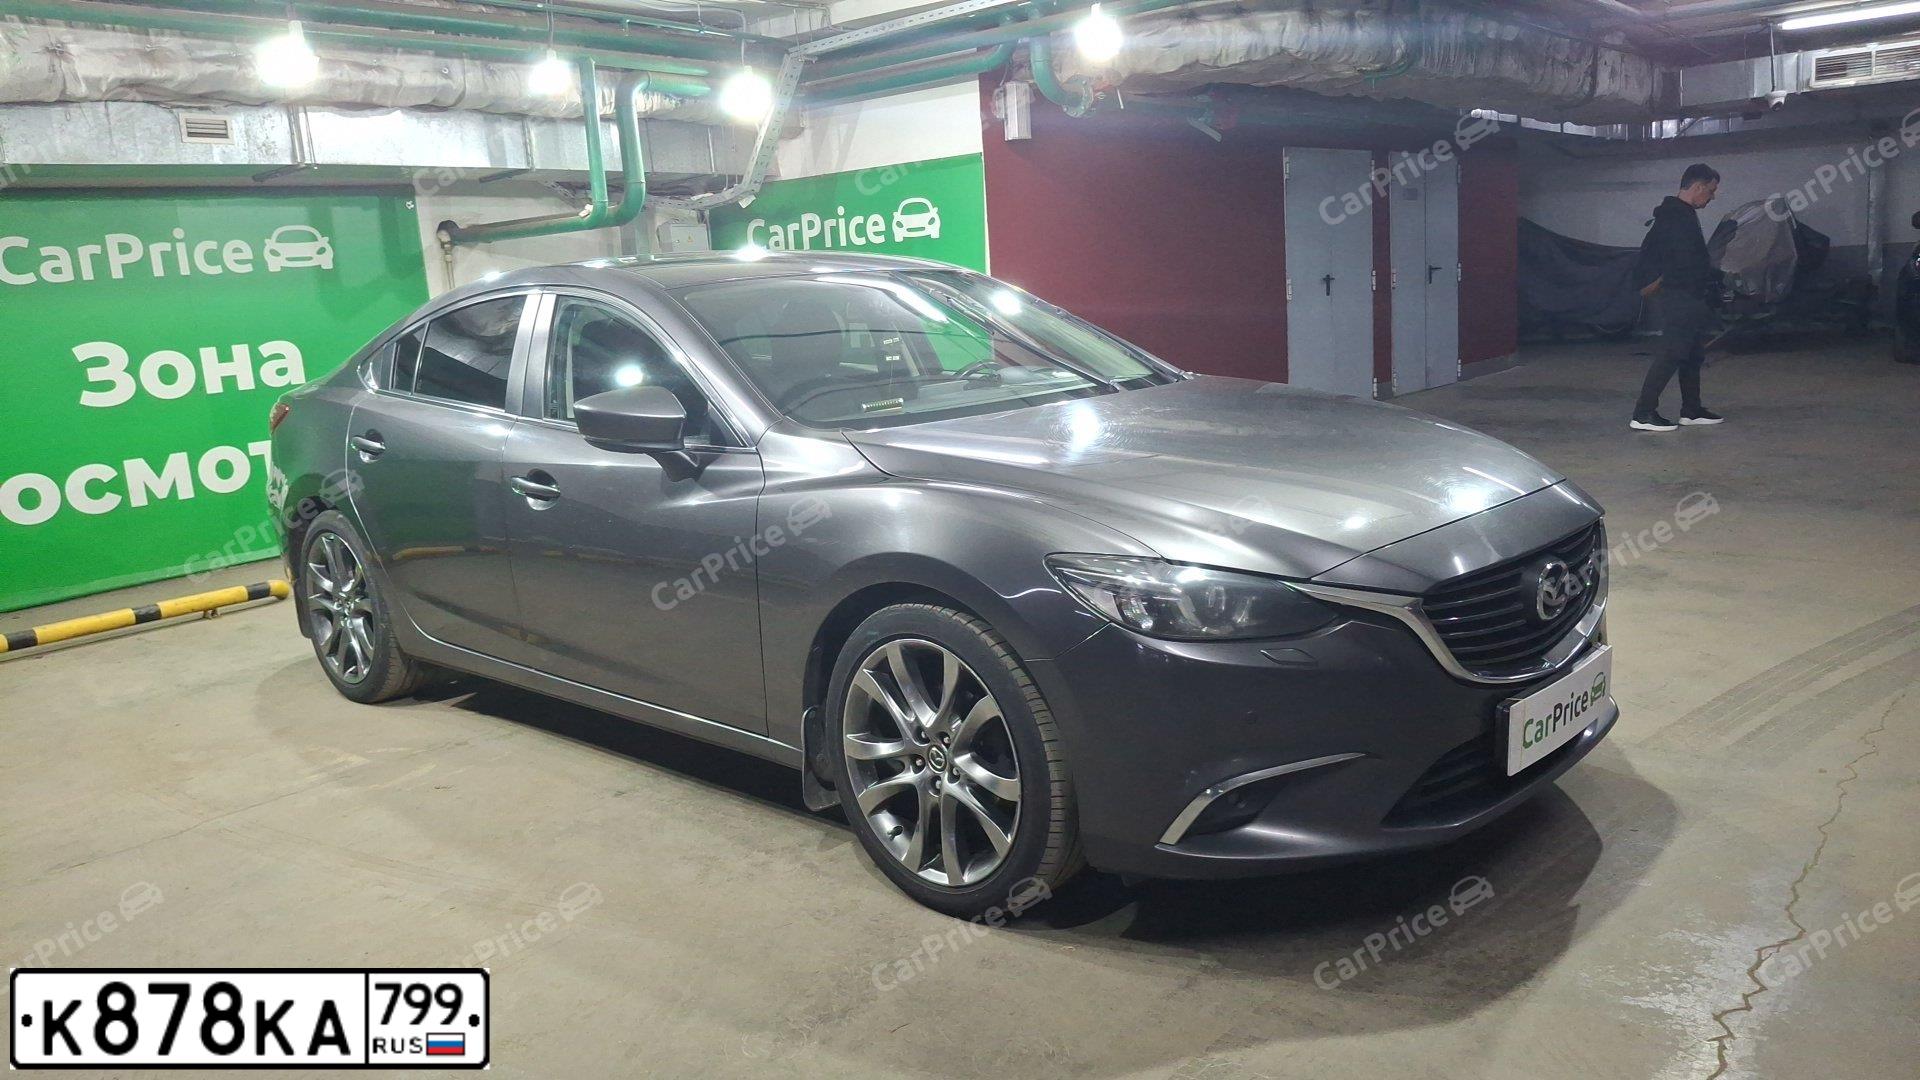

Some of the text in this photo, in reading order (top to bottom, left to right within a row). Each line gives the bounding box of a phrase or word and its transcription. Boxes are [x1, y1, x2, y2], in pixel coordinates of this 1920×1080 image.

[0, 227, 254, 286] CarPrice
[746, 205, 886, 251] CarPrice
[72, 340, 306, 408] Зона
[1522, 691, 1589, 750] CarPrice
